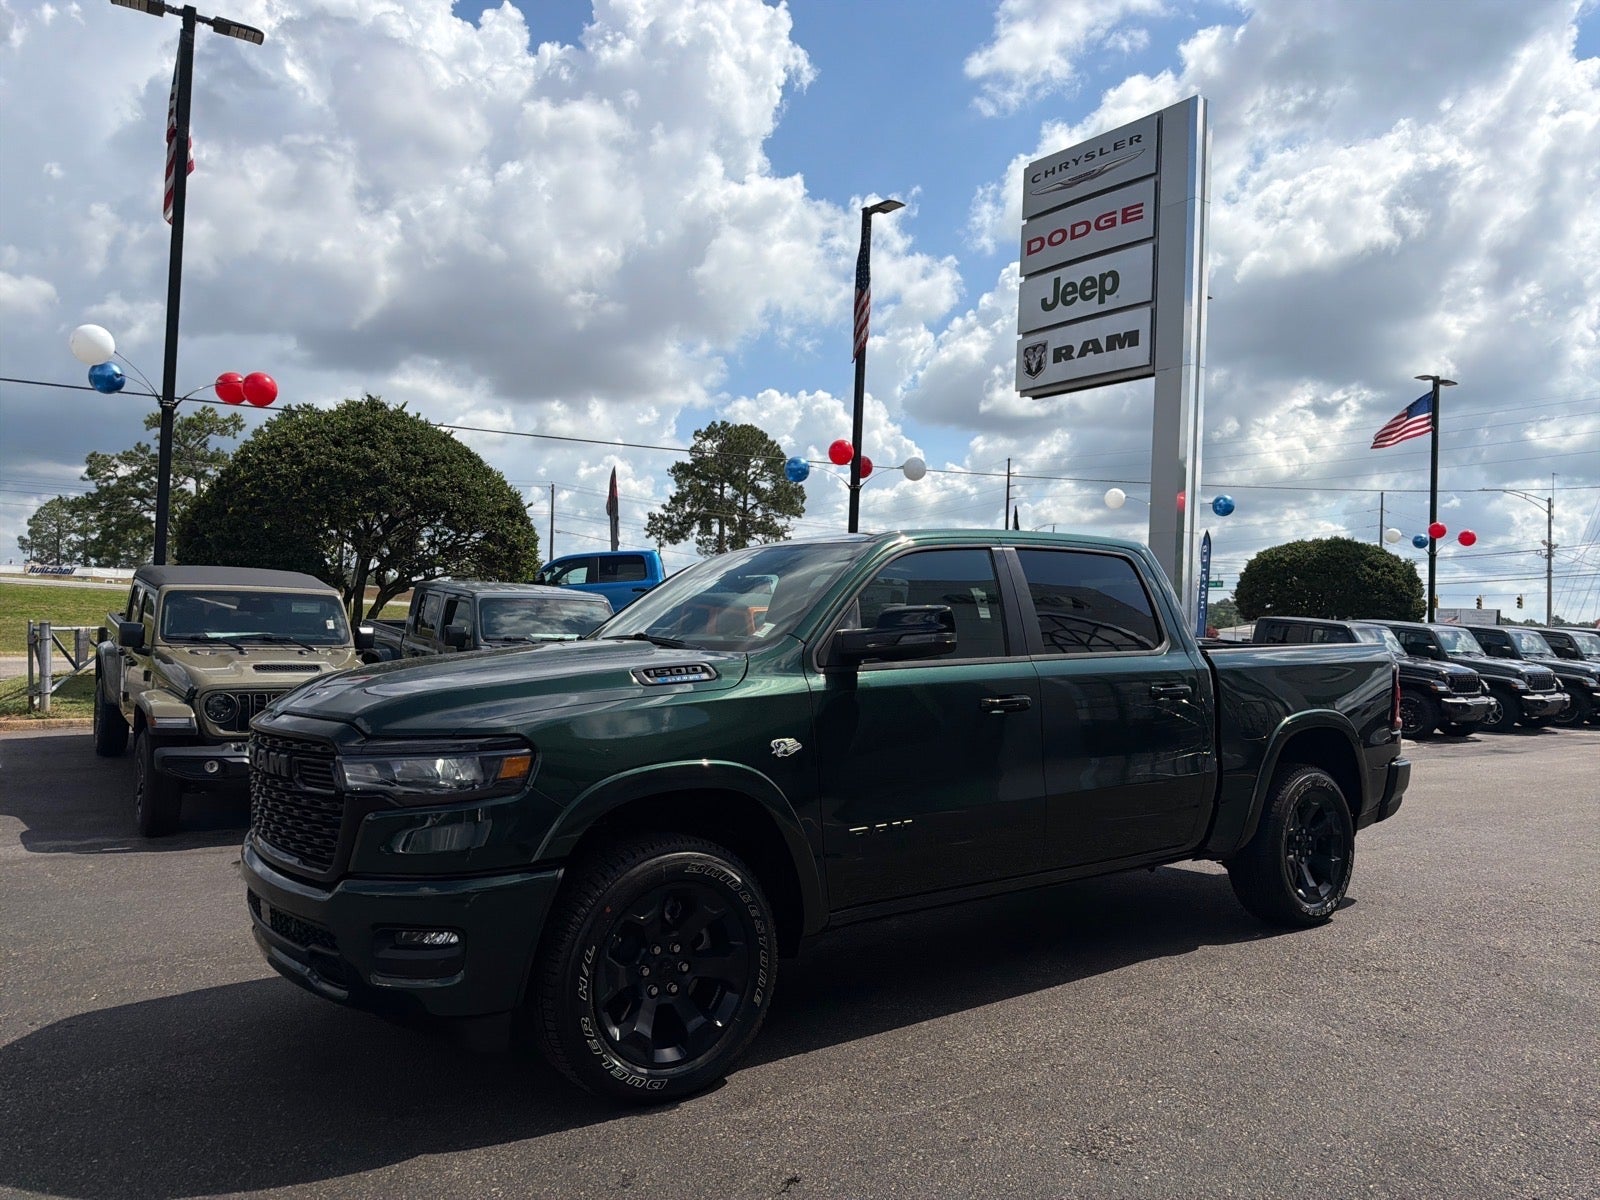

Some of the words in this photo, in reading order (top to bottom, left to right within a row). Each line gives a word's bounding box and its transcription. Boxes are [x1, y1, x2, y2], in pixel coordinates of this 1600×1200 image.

[1031, 134, 1142, 184] CHRYSLER
[1026, 202, 1144, 256] DODGE
[1040, 269, 1119, 312] Jeep
[1053, 329, 1140, 364] RAM
[645, 666, 703, 677] 1500
[580, 1016, 668, 1090] DUELER
